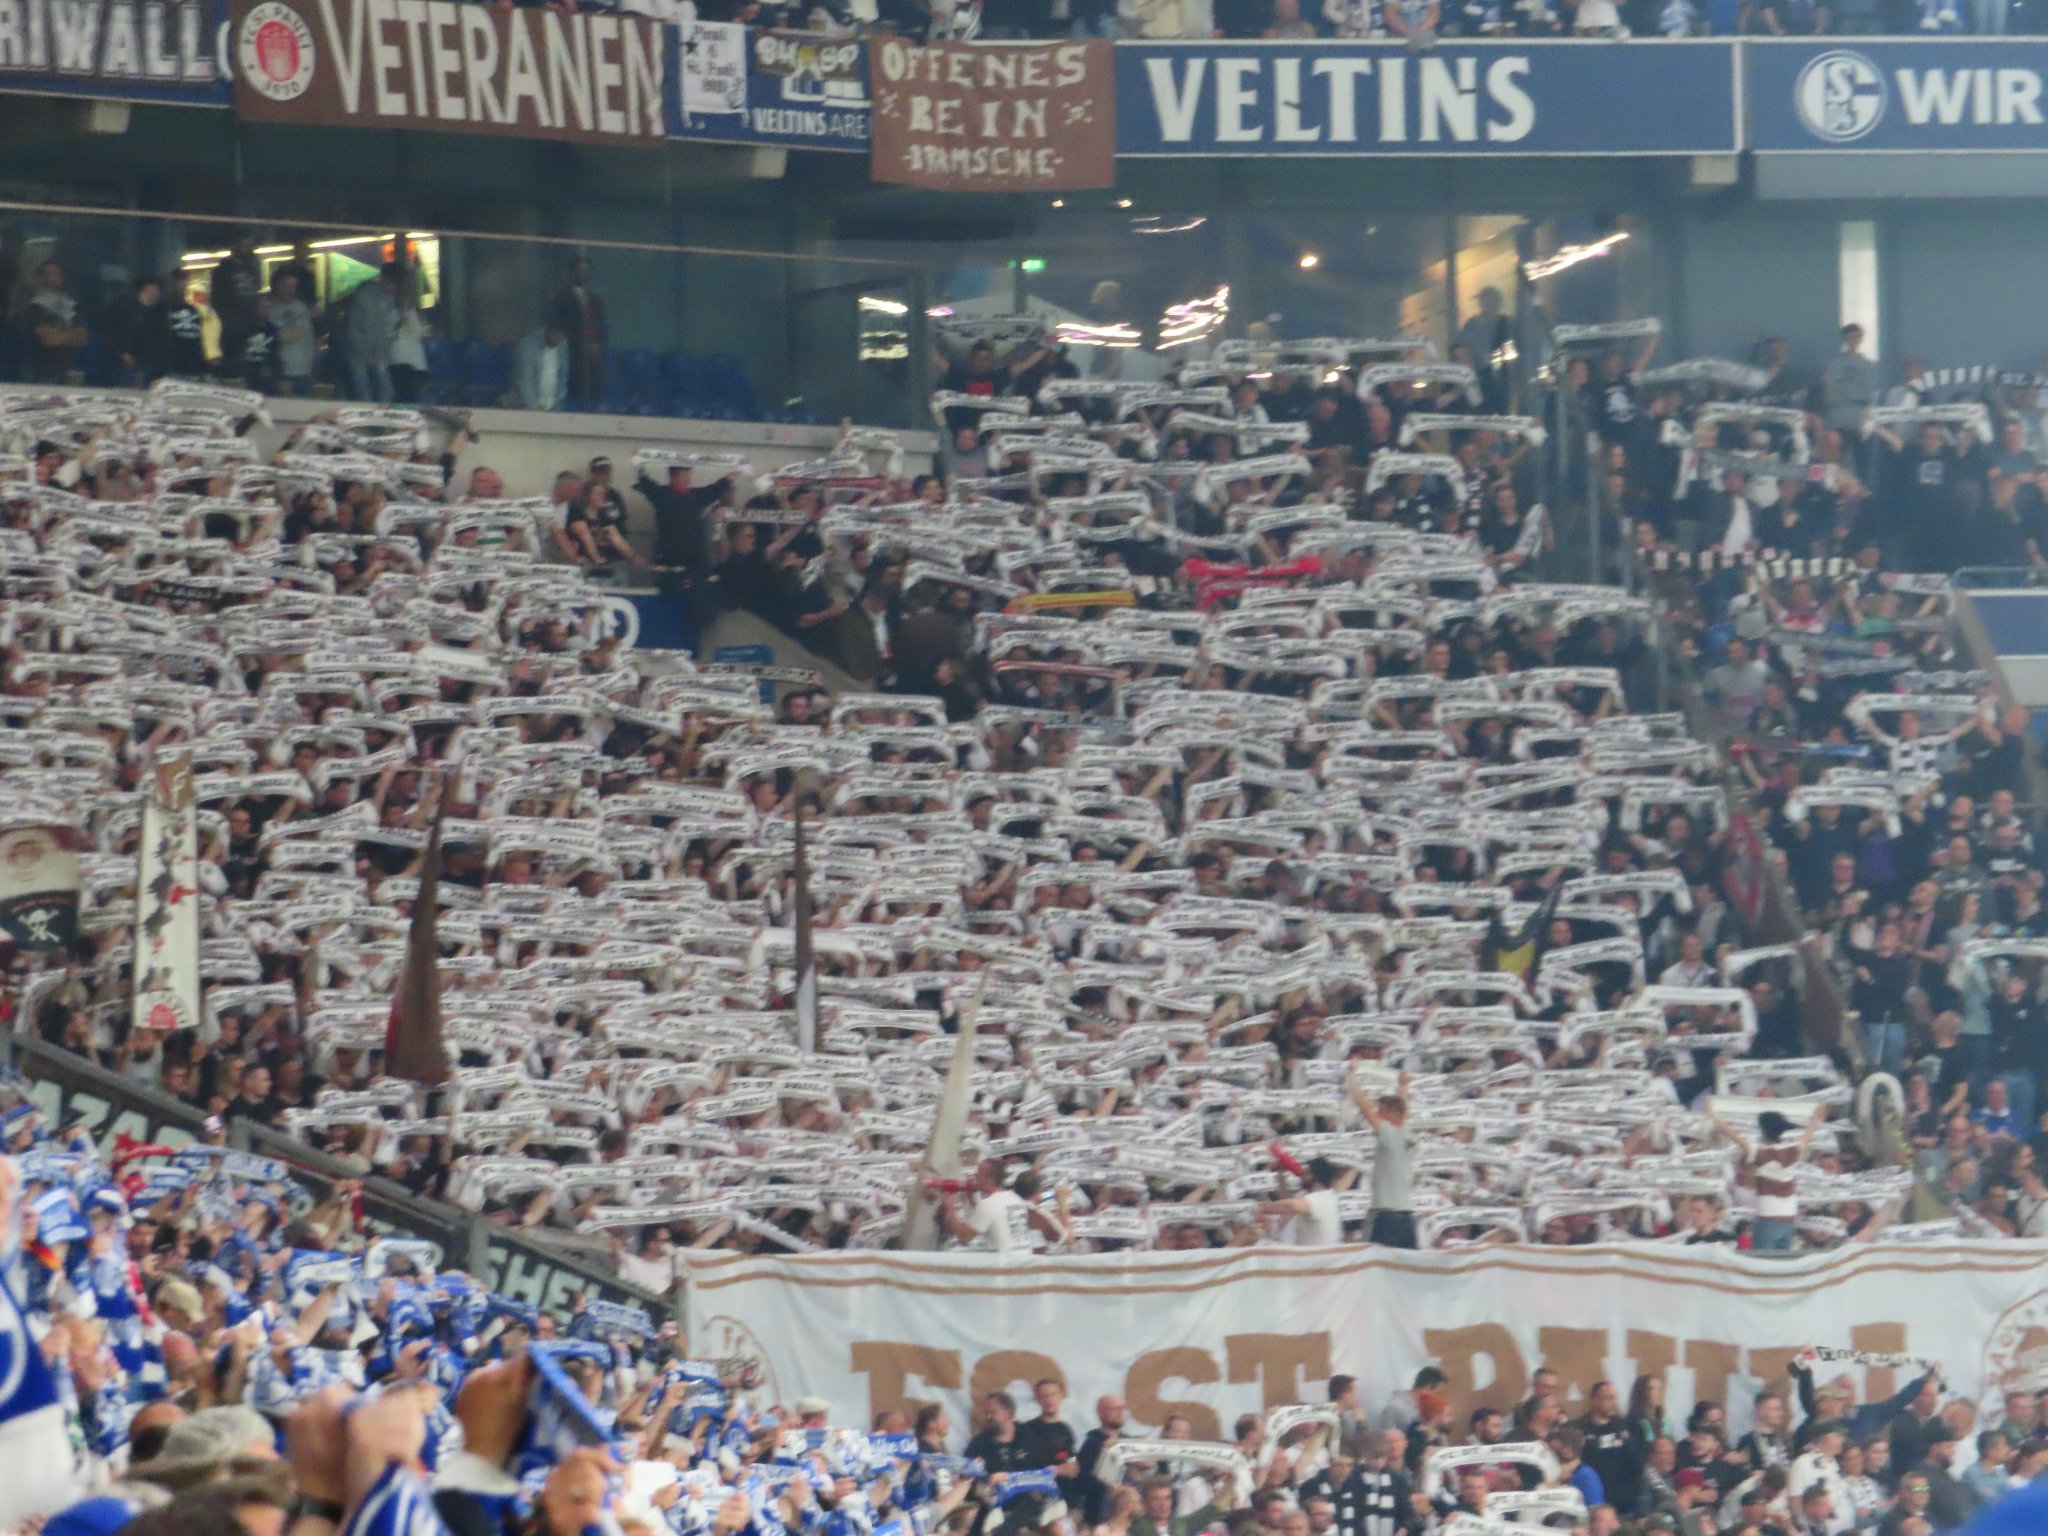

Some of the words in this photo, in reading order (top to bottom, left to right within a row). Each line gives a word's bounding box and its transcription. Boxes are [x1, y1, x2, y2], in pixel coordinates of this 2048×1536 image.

[319, 0, 665, 136] VETERANEN
[881, 42, 1087, 89] OFFENES
[753, 106, 827, 136] VELTINS
[1145, 56, 1536, 143] VELTINS
[1896, 68, 2045, 125] WIR
